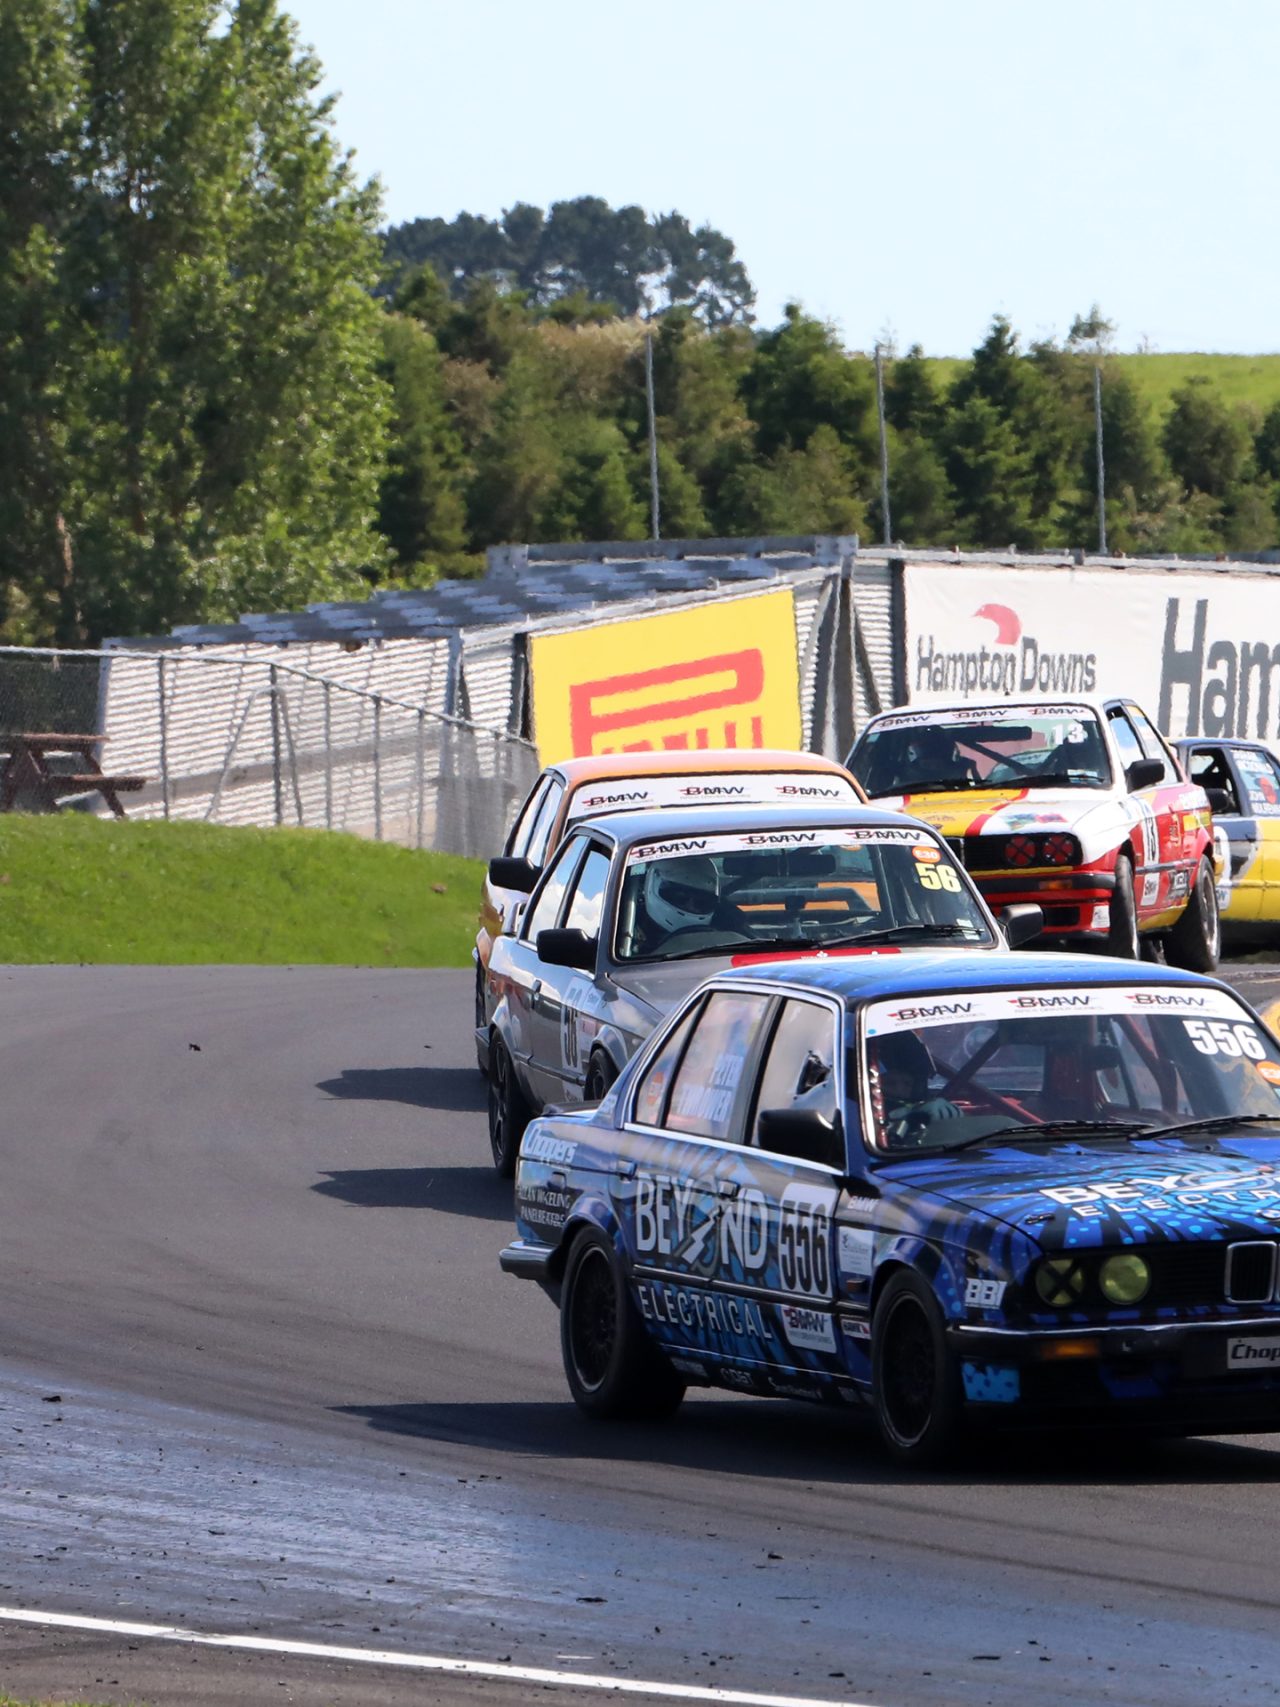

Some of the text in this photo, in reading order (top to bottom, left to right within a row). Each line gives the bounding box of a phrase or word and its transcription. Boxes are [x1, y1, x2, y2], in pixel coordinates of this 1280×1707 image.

[917, 634, 1096, 698] Hampton Downs
[1052, 724, 1087, 745] 13
[582, 792, 648, 807] BMW
[681, 786, 745, 796] BMW
[776, 785, 839, 797] BMW
[630, 840, 707, 858] BMW
[741, 833, 816, 845] BMW
[847, 830, 921, 841] BMW
[914, 862, 962, 892] 56
[888, 993, 1204, 1020] BMW BMW BMW
[1182, 1020, 1267, 1060] 556
[847, 1195, 879, 1213] BMW
[780, 1199, 829, 1295] 556
[637, 1285, 773, 1339] ELECTRICAL
[785, 1307, 828, 1334] BMW
